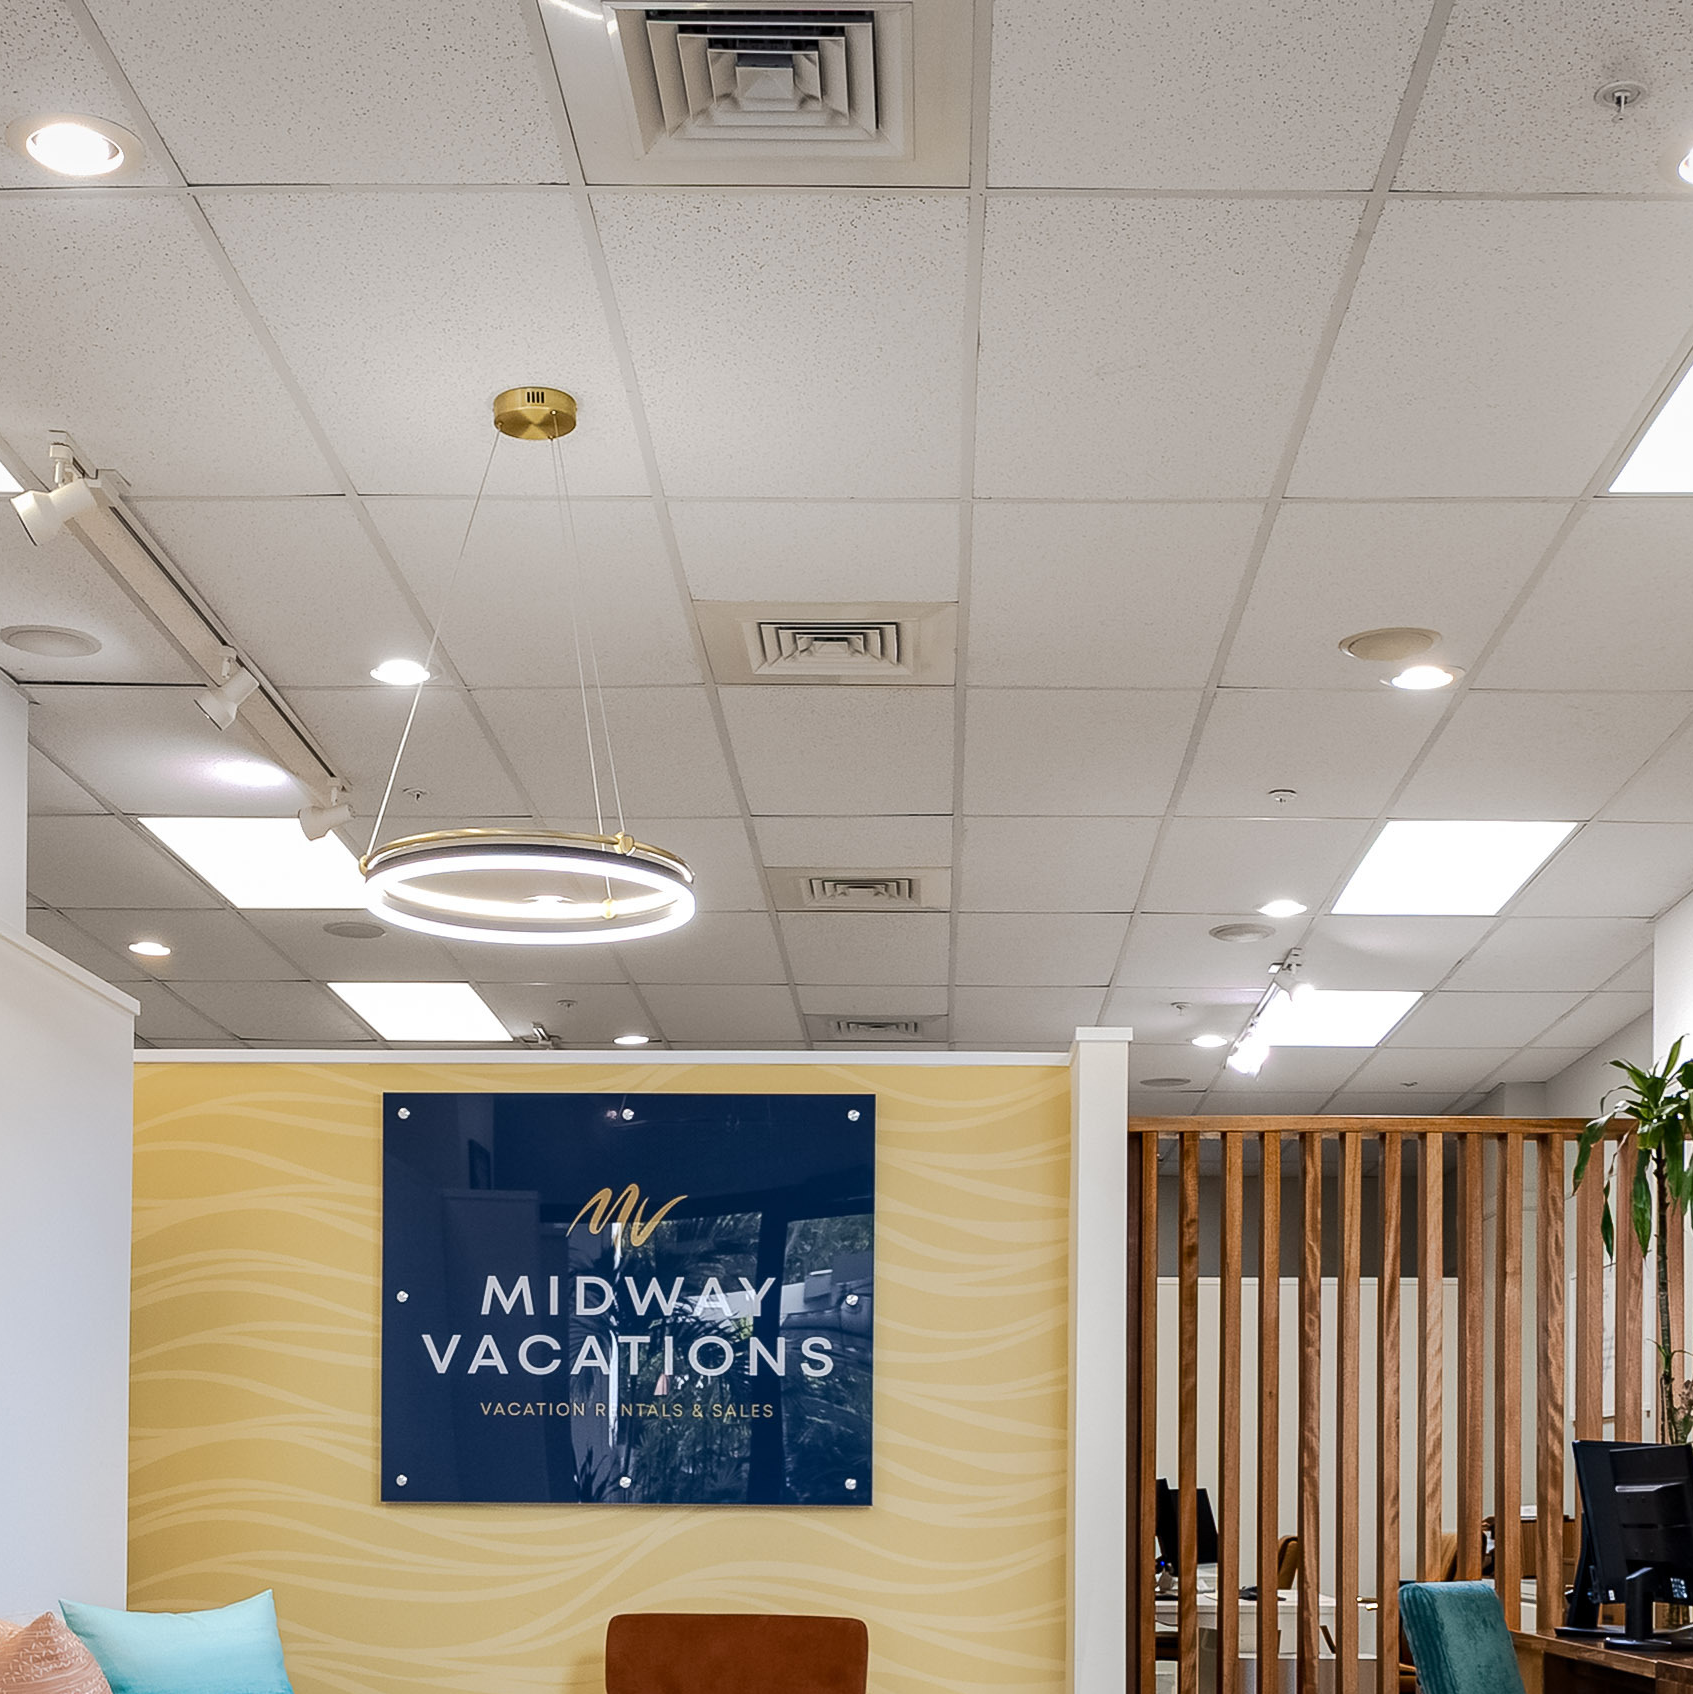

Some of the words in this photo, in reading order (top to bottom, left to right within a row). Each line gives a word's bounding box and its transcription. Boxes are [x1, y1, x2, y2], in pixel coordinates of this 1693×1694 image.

[480, 1275, 776, 1317] MIDWAY
[422, 1334, 835, 1377] VACATIONS
[480, 1402, 586, 1417] VACATION
[691, 1404, 704, 1418] &
[712, 1404, 774, 1418] SALES
